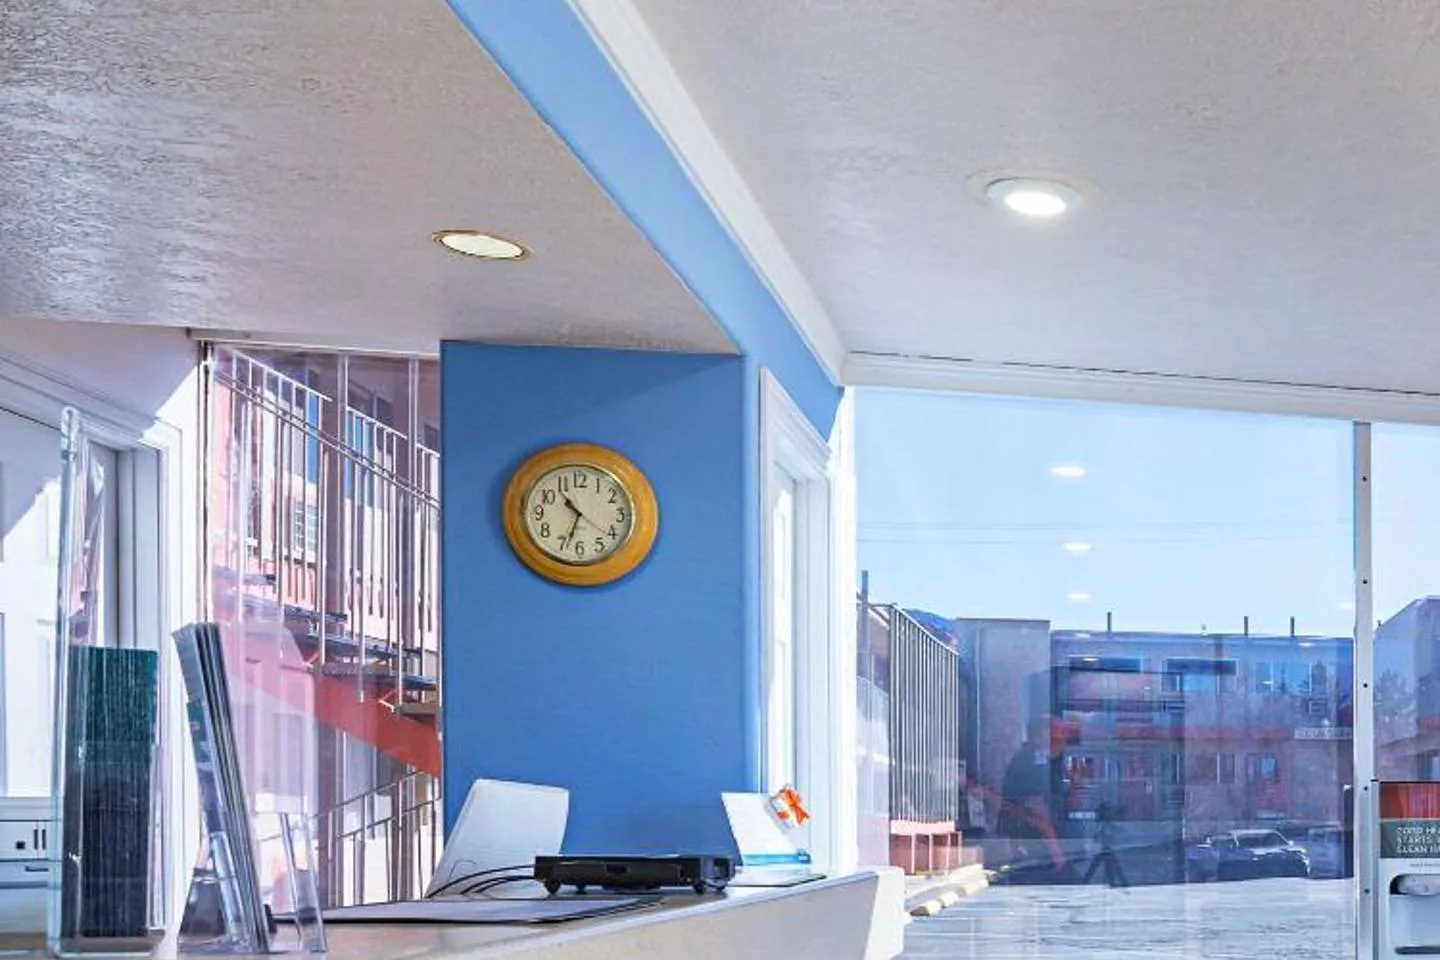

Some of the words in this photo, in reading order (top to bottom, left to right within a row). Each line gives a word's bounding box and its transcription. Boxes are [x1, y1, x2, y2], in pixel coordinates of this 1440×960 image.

[558, 476, 568, 492] 11
[574, 472, 587, 488] 12
[608, 487, 617, 504] 2
[534, 505, 544, 521] 9
[616, 507, 625, 523] 3
[541, 523, 550, 538] 8
[608, 524, 617, 540] 4
[575, 541, 584, 556] 6
